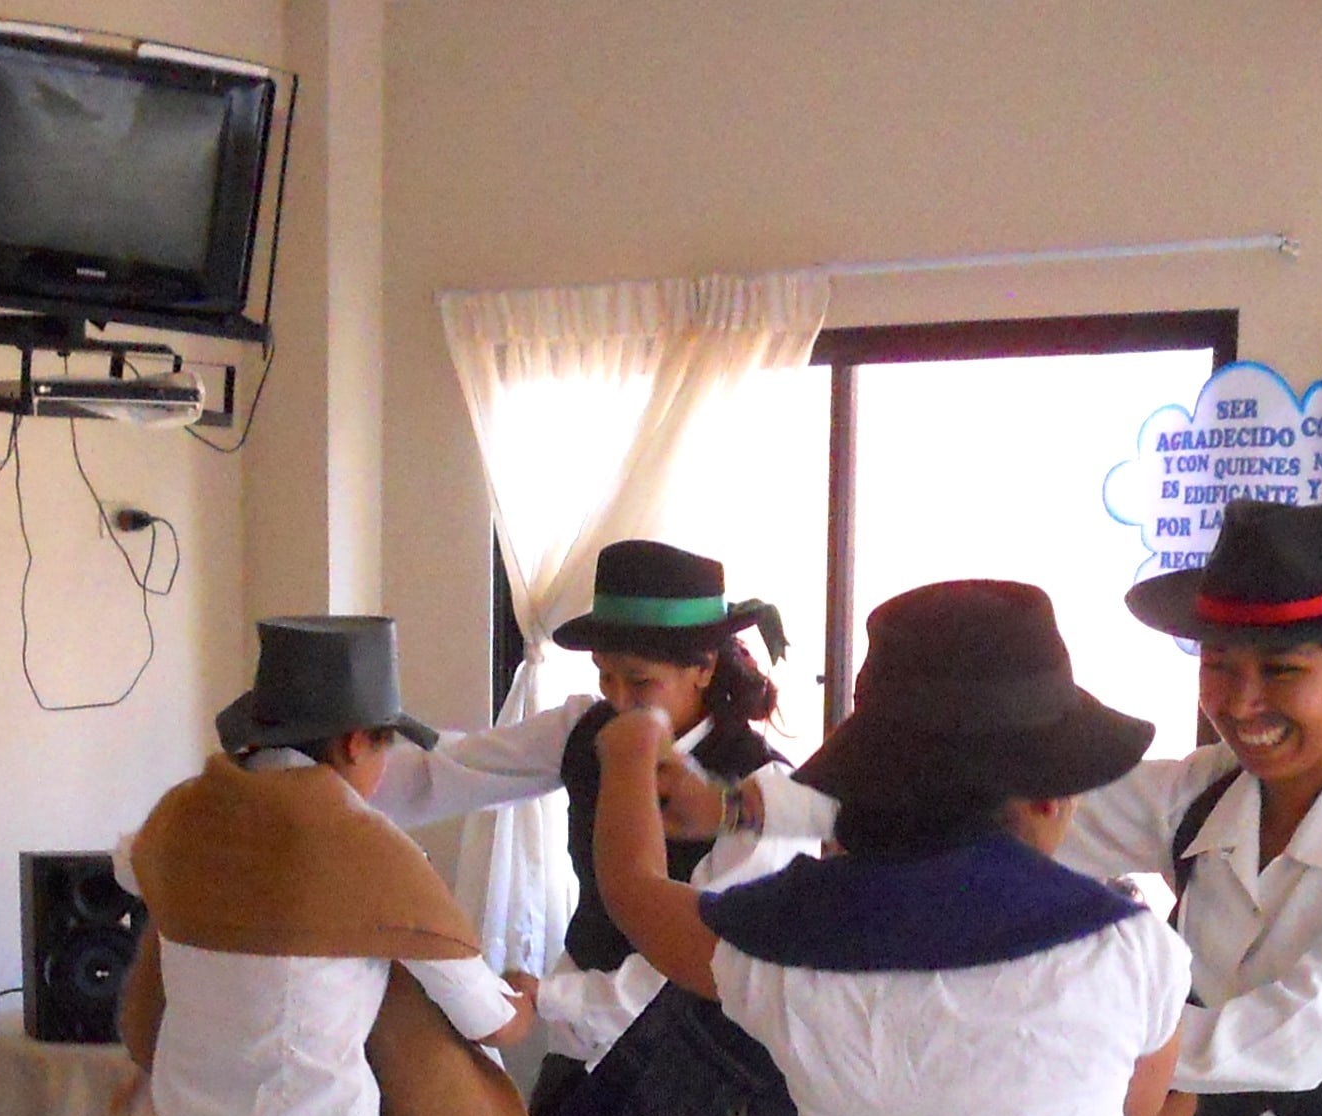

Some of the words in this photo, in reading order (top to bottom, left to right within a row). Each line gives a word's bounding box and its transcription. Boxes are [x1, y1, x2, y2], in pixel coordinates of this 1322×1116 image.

[1217, 399, 1258, 420] SER
[1156, 427, 1295, 451] AGRADECIDO
[1164, 457, 1175, 474] Y
[1177, 455, 1210, 472] CON
[1214, 457, 1300, 479] QUIENES
[1161, 480, 1179, 498] ES
[1184, 485, 1298, 507] EDIFICANTE
[1308, 479, 1322, 499] Y
[1156, 517, 1191, 536] POR
[1160, 552, 1210, 569] RECI
